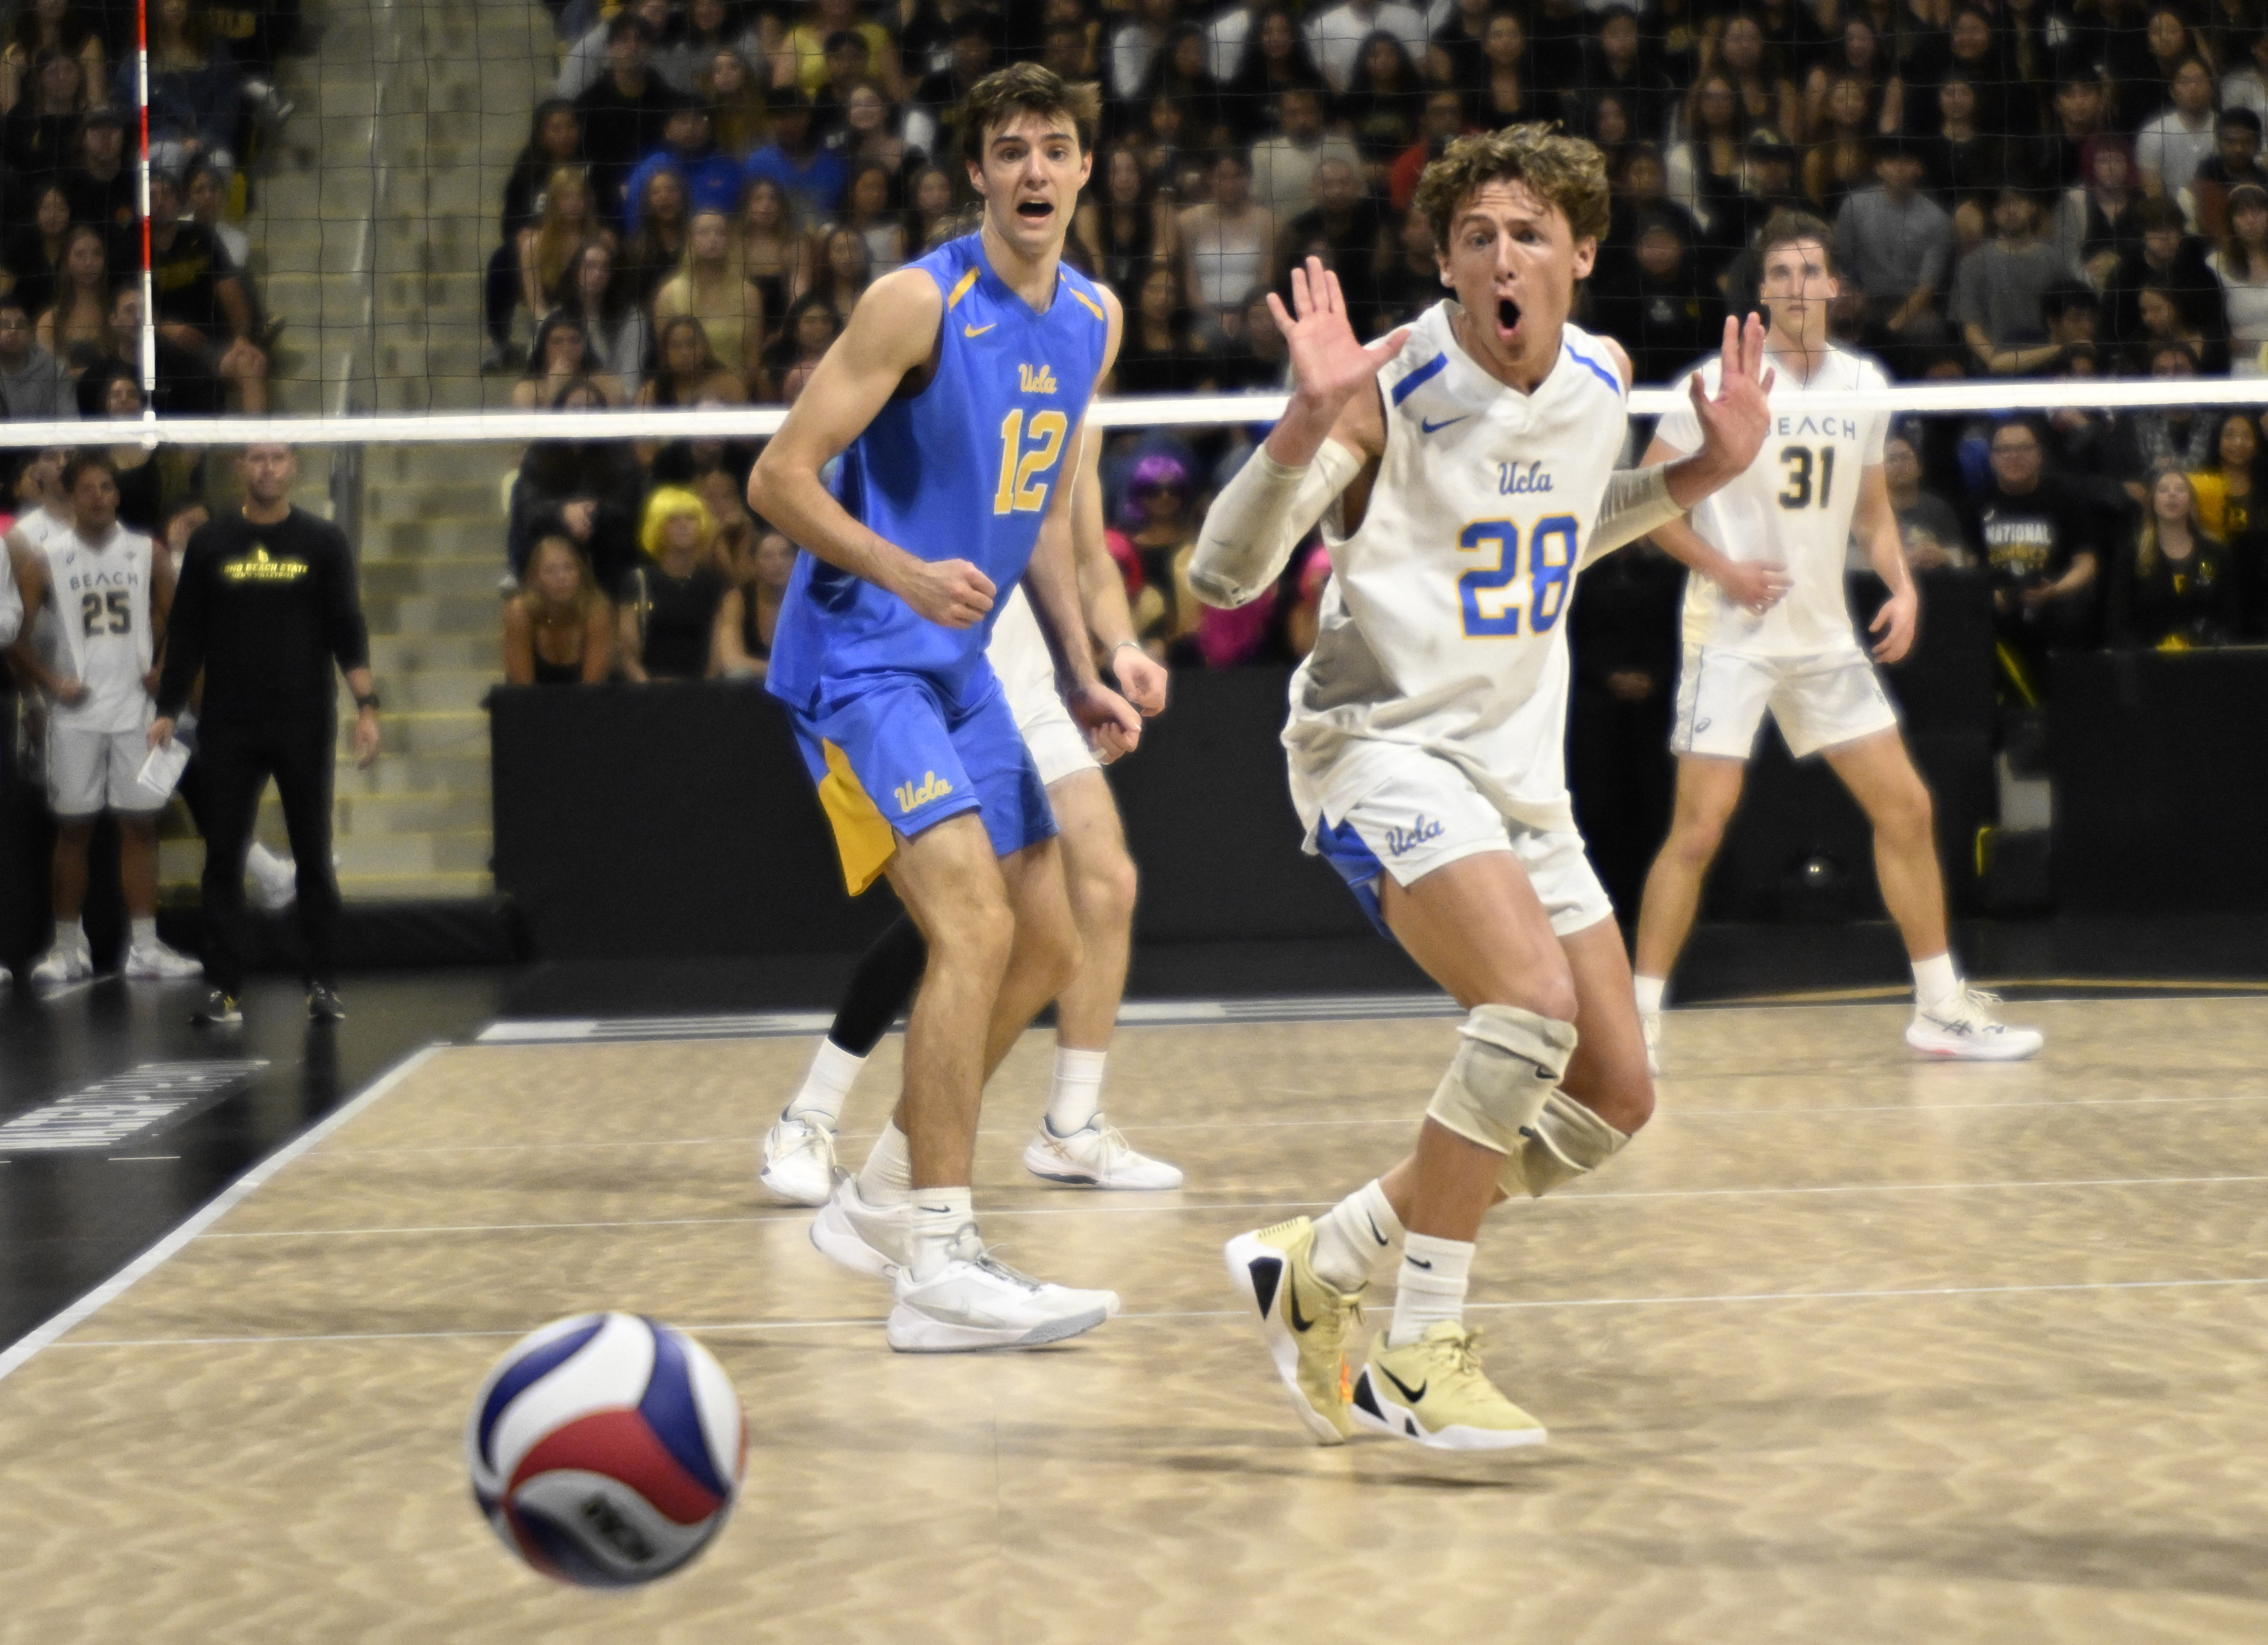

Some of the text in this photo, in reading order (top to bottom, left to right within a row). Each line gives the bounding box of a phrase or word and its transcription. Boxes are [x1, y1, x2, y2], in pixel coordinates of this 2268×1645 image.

[1765, 416, 1856, 440] EACH
[994, 409, 1067, 515] 12
[1778, 444, 1835, 510] 31
[1985, 523, 2051, 544] NATIONAL
[70, 571, 138, 590] BEACH
[245, 563, 277, 571] BEACH
[280, 563, 309, 573] STATE
[1456, 512, 1580, 640] 28
[81, 591, 131, 637] 25
